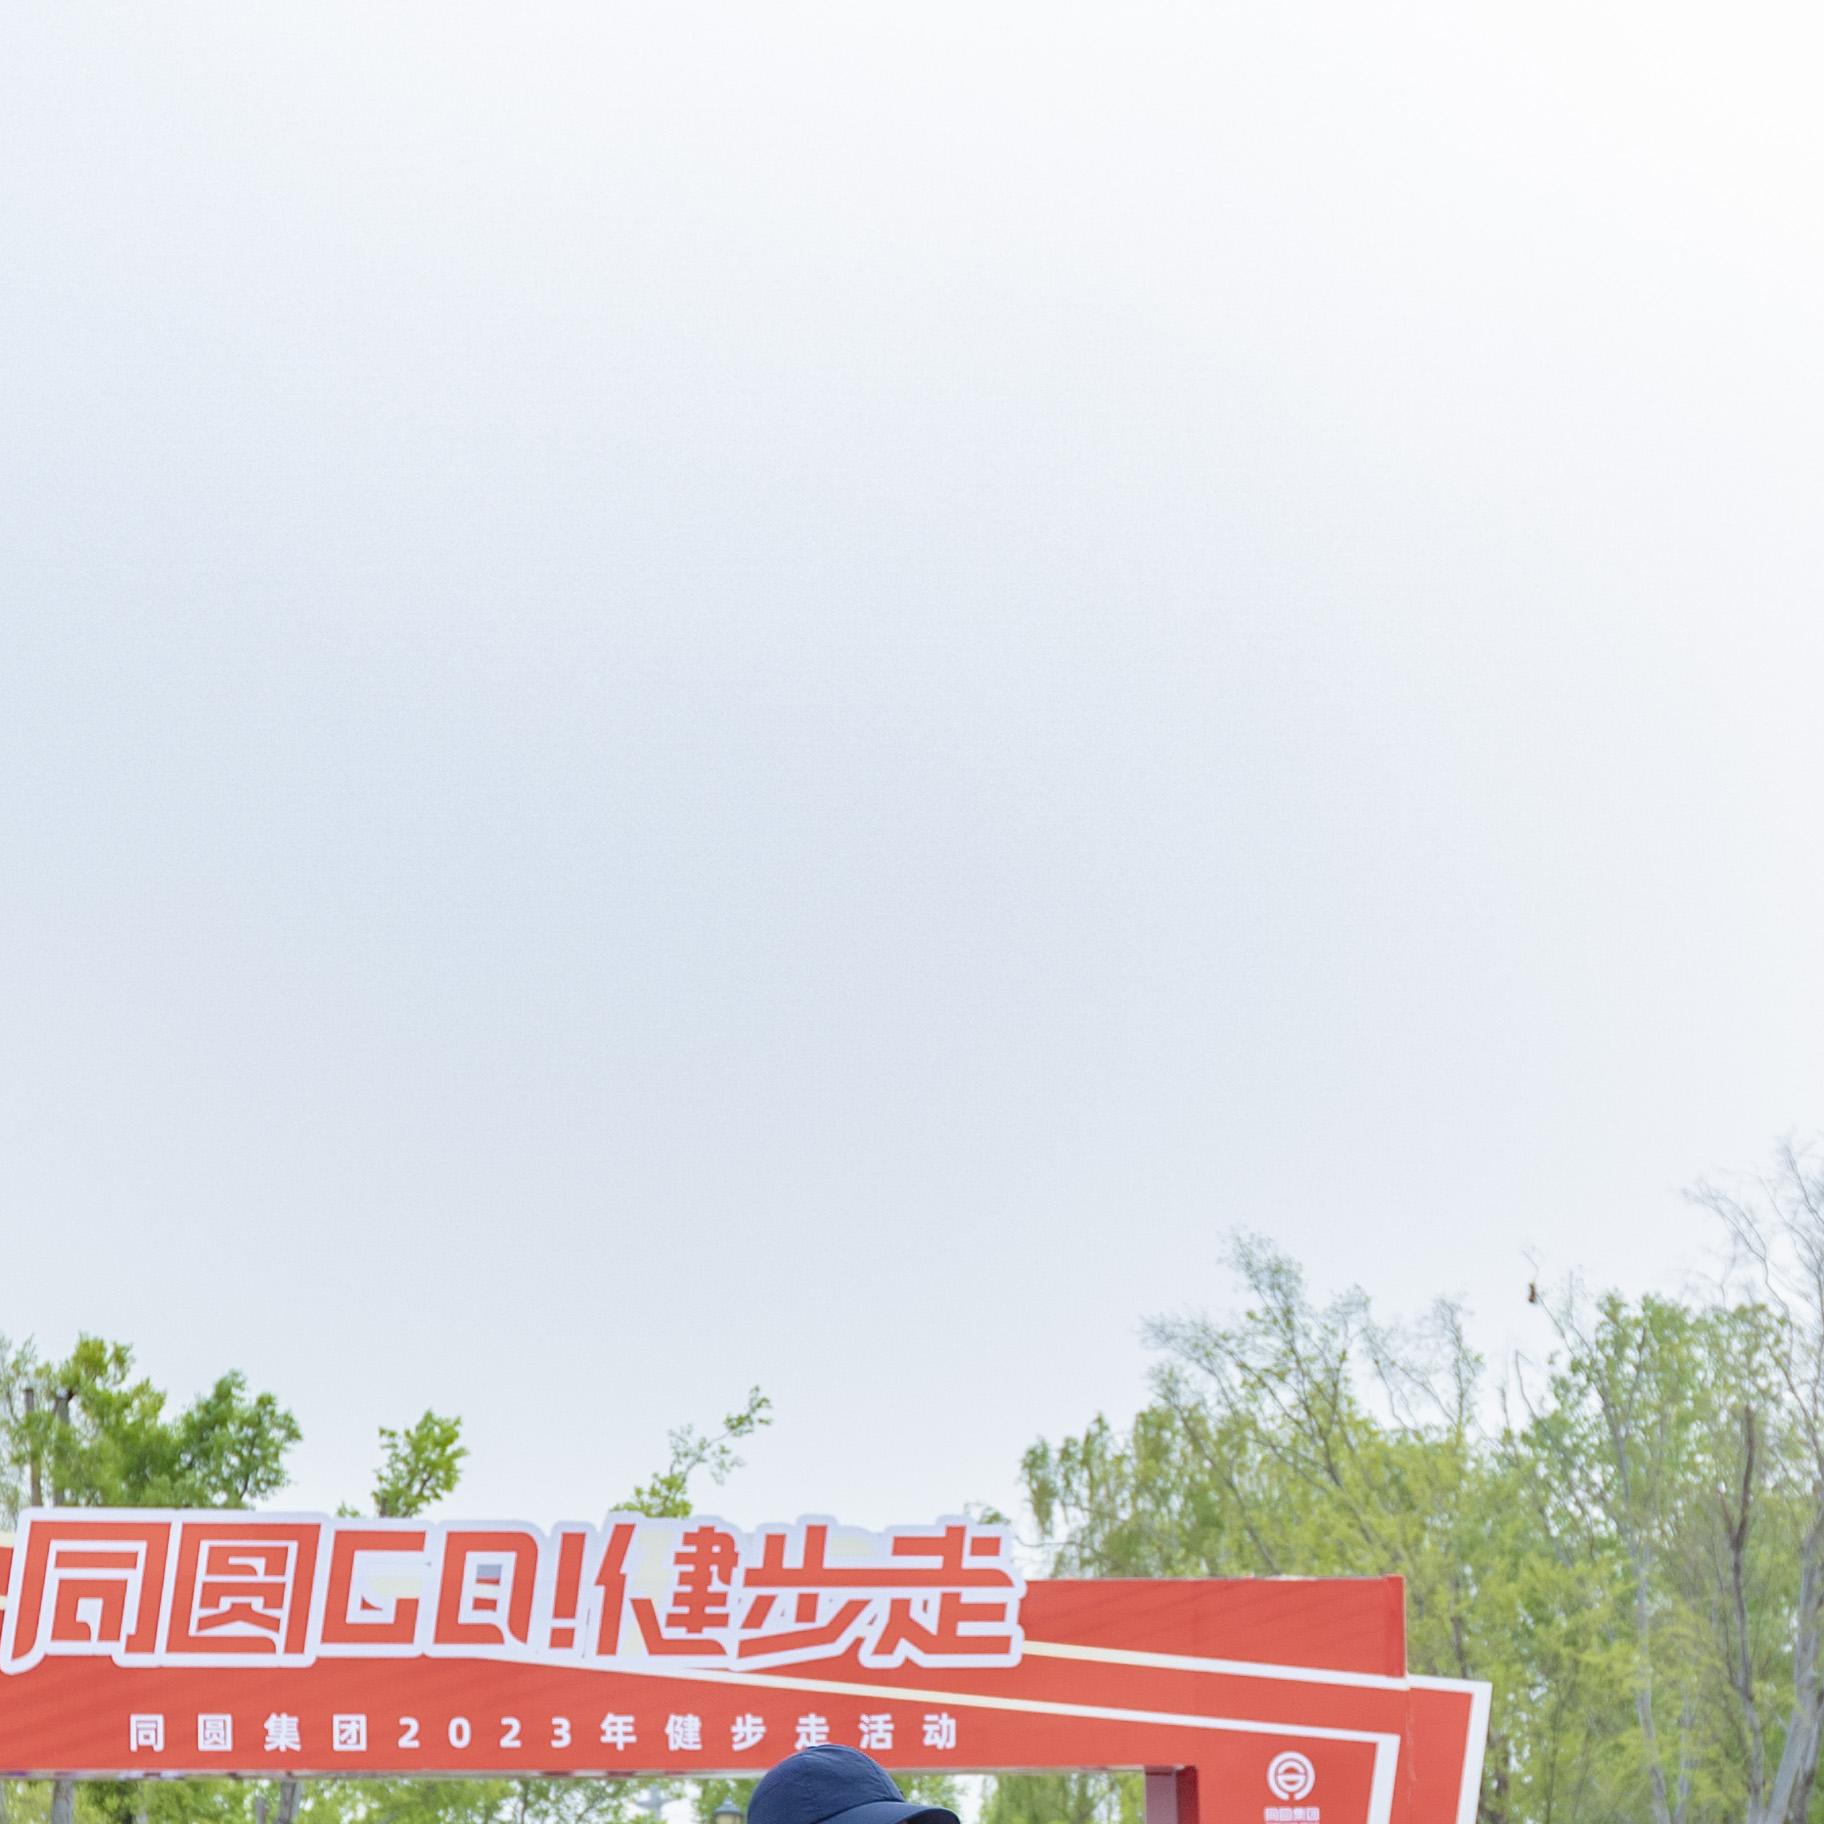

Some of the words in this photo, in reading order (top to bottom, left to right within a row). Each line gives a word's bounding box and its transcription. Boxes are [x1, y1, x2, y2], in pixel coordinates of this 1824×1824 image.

[129, 1712, 958, 1754] 同圆集团2023年健步走活动
